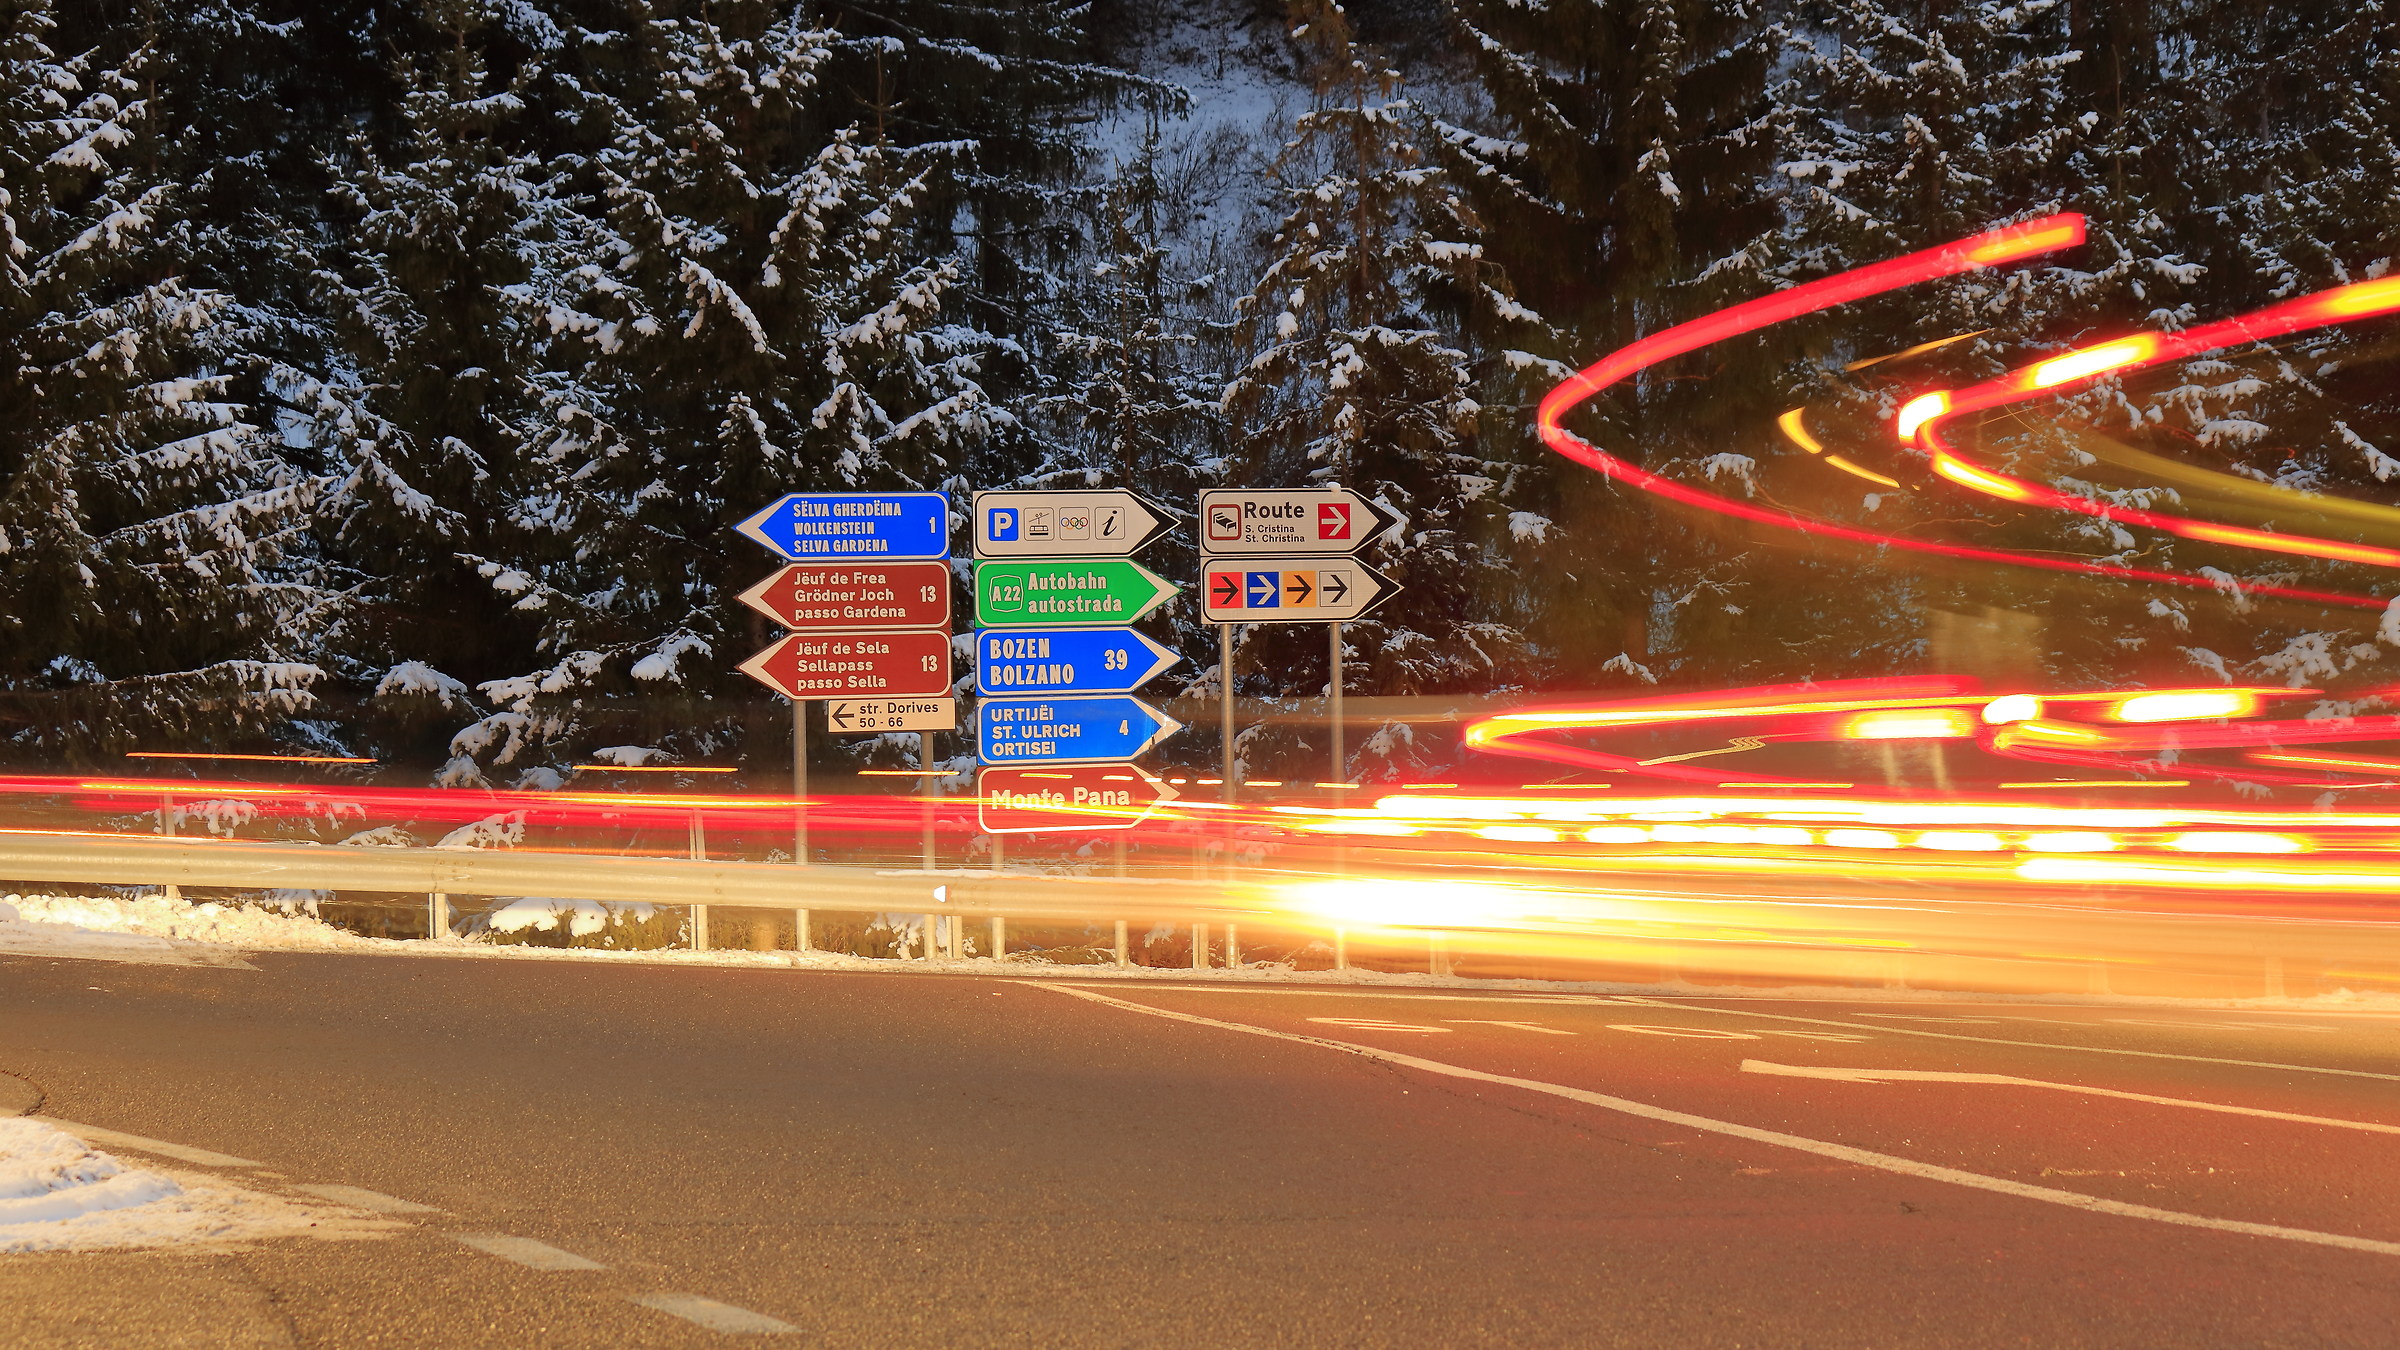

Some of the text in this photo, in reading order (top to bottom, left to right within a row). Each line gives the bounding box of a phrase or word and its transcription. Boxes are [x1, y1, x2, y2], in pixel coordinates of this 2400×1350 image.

[793, 500, 901, 517] SËLVA GHERDËINA
[1244, 501, 1305, 518] Route
[794, 521, 875, 535] WOLKENSTEIN
[928, 517, 936, 533] 1
[994, 512, 1013, 537] P
[1245, 524, 1295, 533] S. Cristina
[794, 539, 888, 553] SELVA GARDENA
[1245, 534, 1305, 543] St. Christina
[794, 572, 886, 585] Jëuf de Frea
[1028, 572, 1107, 590] Autobahn
[795, 589, 894, 602] Grödner Joch
[920, 586, 936, 602] 13
[1028, 595, 1122, 613] autostrada
[795, 606, 906, 621] passo Gardena
[796, 642, 890, 656] Jëuf de Sela
[990, 638, 1050, 658] BOZEN
[798, 659, 873, 673] Sellapass
[921, 656, 938, 672] 13
[1104, 649, 1128, 671] 39
[990, 664, 1075, 685] BOLZANO
[797, 675, 887, 691] passo Sella
[860, 702, 939, 714] str. Dorives
[991, 704, 1054, 722] URTIJËI
[860, 717, 876, 727] 50
[888, 717, 903, 727] 66
[1119, 720, 1129, 735] 4
[992, 724, 1081, 739] ST. ULRICH
[992, 742, 1055, 756] ORTISEI
[991, 786, 1130, 809] Monte Pana
[1305, 1017, 1875, 1044] STOP
